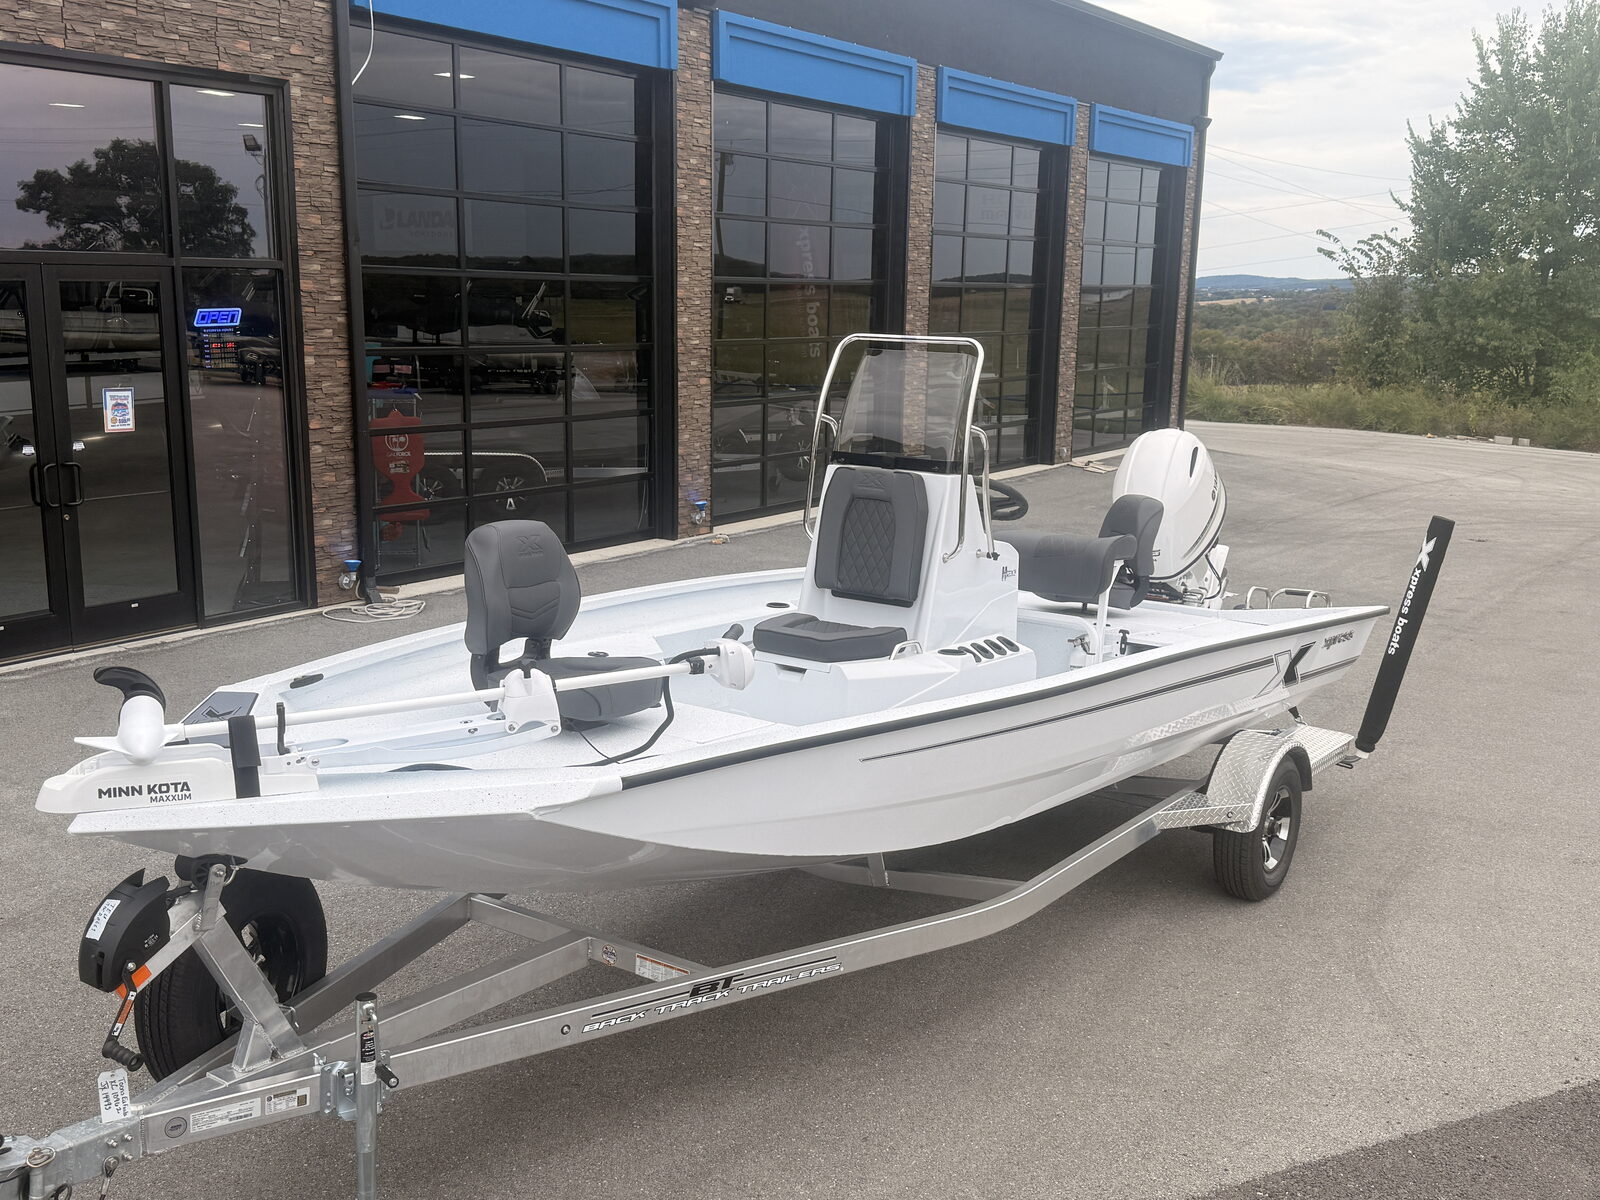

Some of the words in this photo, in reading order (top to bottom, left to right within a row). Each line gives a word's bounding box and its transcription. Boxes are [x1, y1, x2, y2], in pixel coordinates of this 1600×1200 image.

[397, 210, 456, 228] LANDA
[198, 311, 239, 324] OPEN
[1401, 567, 1422, 615] xpress
[1387, 616, 1408, 656] boats
[98, 784, 143, 799] MINN
[147, 781, 191, 795] KOTA
[150, 793, 192, 803] MAXXUM
[689, 973, 745, 998] BT
[581, 1008, 651, 1034] BACK
[654, 987, 735, 1015] TRACK
[737, 962, 842, 994] TRAILERS
